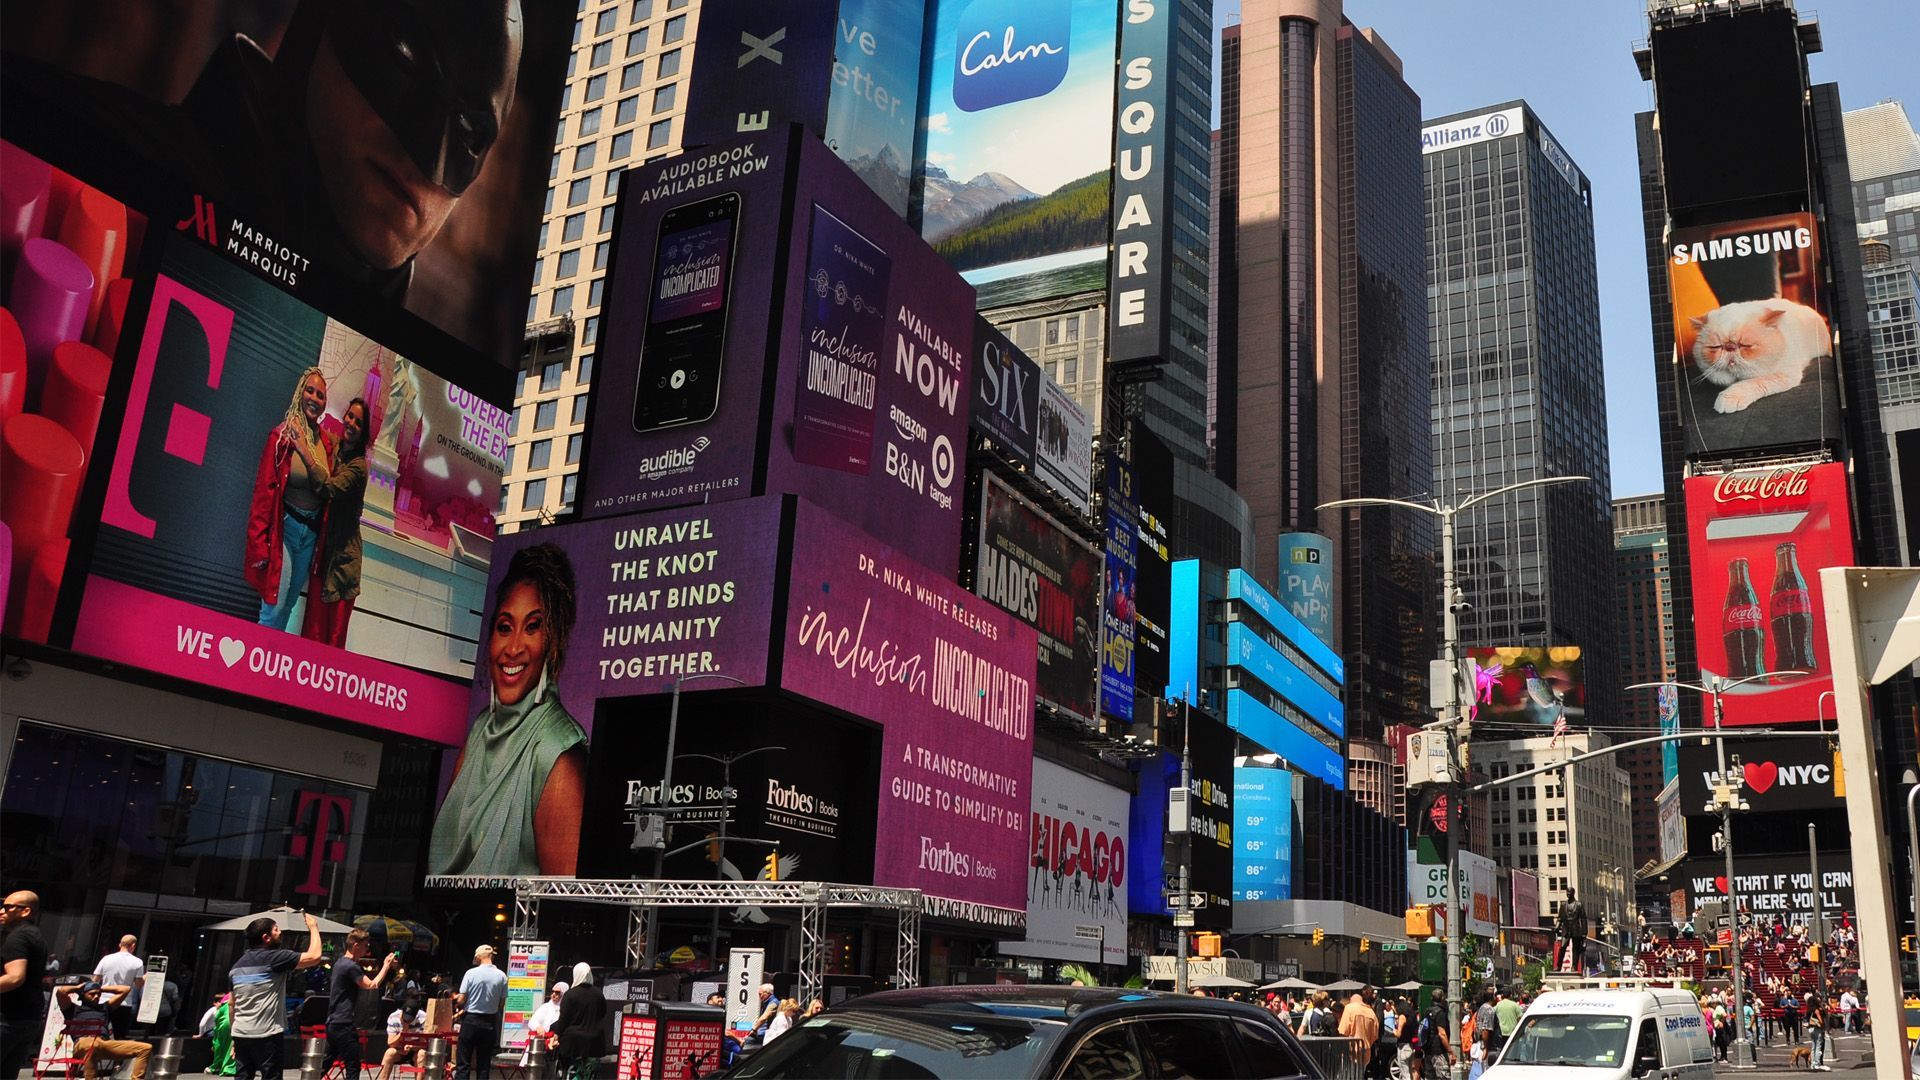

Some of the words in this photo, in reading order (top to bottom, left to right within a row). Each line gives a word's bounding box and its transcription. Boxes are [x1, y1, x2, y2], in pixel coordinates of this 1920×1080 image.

[960, 25, 1063, 76] Calm
[1422, 123, 1481, 148] Allianz
[640, 169, 724, 204] AVAILABLE
[729, 156, 769, 178] NOW
[658, 143, 754, 183] AUDIOBOOK
[1116, 56, 1155, 327] SQUARE
[227, 238, 297, 286] MARQUIS
[231, 219, 310, 272] MARRIOTT
[1673, 227, 1811, 265] SAMSUNG
[660, 265, 720, 300] UNCOMPLICATED
[811, 324, 877, 370] inclusion
[898, 305, 962, 372] AVAILABLE
[807, 350, 876, 411] UNCOMPLICATED
[895, 333, 960, 416] NOW
[980, 341, 1029, 436] SIX
[462, 416, 490, 450] THE
[890, 404, 927, 443] amazon
[437, 434, 447, 447] ON
[447, 438, 461, 454] THE
[488, 462, 495, 472] IN
[639, 447, 696, 474] audible
[885, 441, 924, 496] B&N
[647, 469, 667, 480] amazon
[668, 465, 695, 475] company
[1119, 466, 1131, 498] 13
[1713, 464, 1811, 503] Coca-Cola
[595, 498, 614, 508] AND
[617, 491, 648, 505] OTHER
[651, 486, 684, 499] MAJOR
[687, 477, 740, 492] RETAILERS
[929, 482, 952, 511] target
[614, 518, 713, 551] UNRAVEL
[1106, 537, 1137, 570] MUSICAL
[1115, 526, 1130, 548] BEST
[611, 559, 650, 582] THE
[656, 550, 718, 577] KNOT
[607, 589, 661, 615] THAT
[666, 581, 735, 609] BINDS
[858, 553, 879, 579] DR.
[883, 568, 912, 597] NIKA
[916, 584, 948, 616] WHITE
[952, 604, 998, 641] RELEASES
[602, 616, 722, 648] HUMANITY
[1104, 609, 1119, 633] SOME
[1119, 620, 1130, 637] LIKE
[1130, 623, 1135, 641] A
[599, 651, 720, 681] TOGETHER.
[798, 598, 926, 696] inclusion
[1102, 626, 1134, 678] HOT
[177, 625, 213, 659] WE
[249, 647, 293, 681] OUR
[296, 660, 408, 712] CUSTOMERS
[932, 636, 1028, 741] UNCOMPLICATED
[903, 743, 912, 765] A
[917, 747, 1017, 798] TRANSFORMATIVE
[1778, 763, 1830, 786] NYC
[766, 778, 814, 814] Forbes
[820, 801, 839, 818] Books
[891, 776, 931, 806] GUIDE
[935, 789, 951, 811] TO
[954, 795, 1004, 826] SIMPLIFY
[1006, 810, 1023, 832] DEI
[1202, 779, 1211, 803] OR
[1211, 783, 1229, 809] Drive.
[1208, 818, 1217, 840] No
[918, 836, 970, 878] Forbes
[976, 860, 997, 880] Books
[425, 878, 476, 889] AMERICAN
[478, 878, 510, 889] EAGLE
[1692, 877, 1715, 893] WE
[1734, 875, 1770, 891] THAT
[1774, 874, 1787, 890] IF
[1823, 872, 1852, 888] CAN
[1753, 894, 1787, 909] HERE
[939, 897, 970, 921] EAGLE
[972, 901, 1027, 929] OUTFITTERS
[515, 945, 533, 954] TSQ
[739, 954, 751, 1005] TSQ
[1664, 1017, 1679, 1030] Cool
[1680, 1016, 1701, 1029] Breeze
